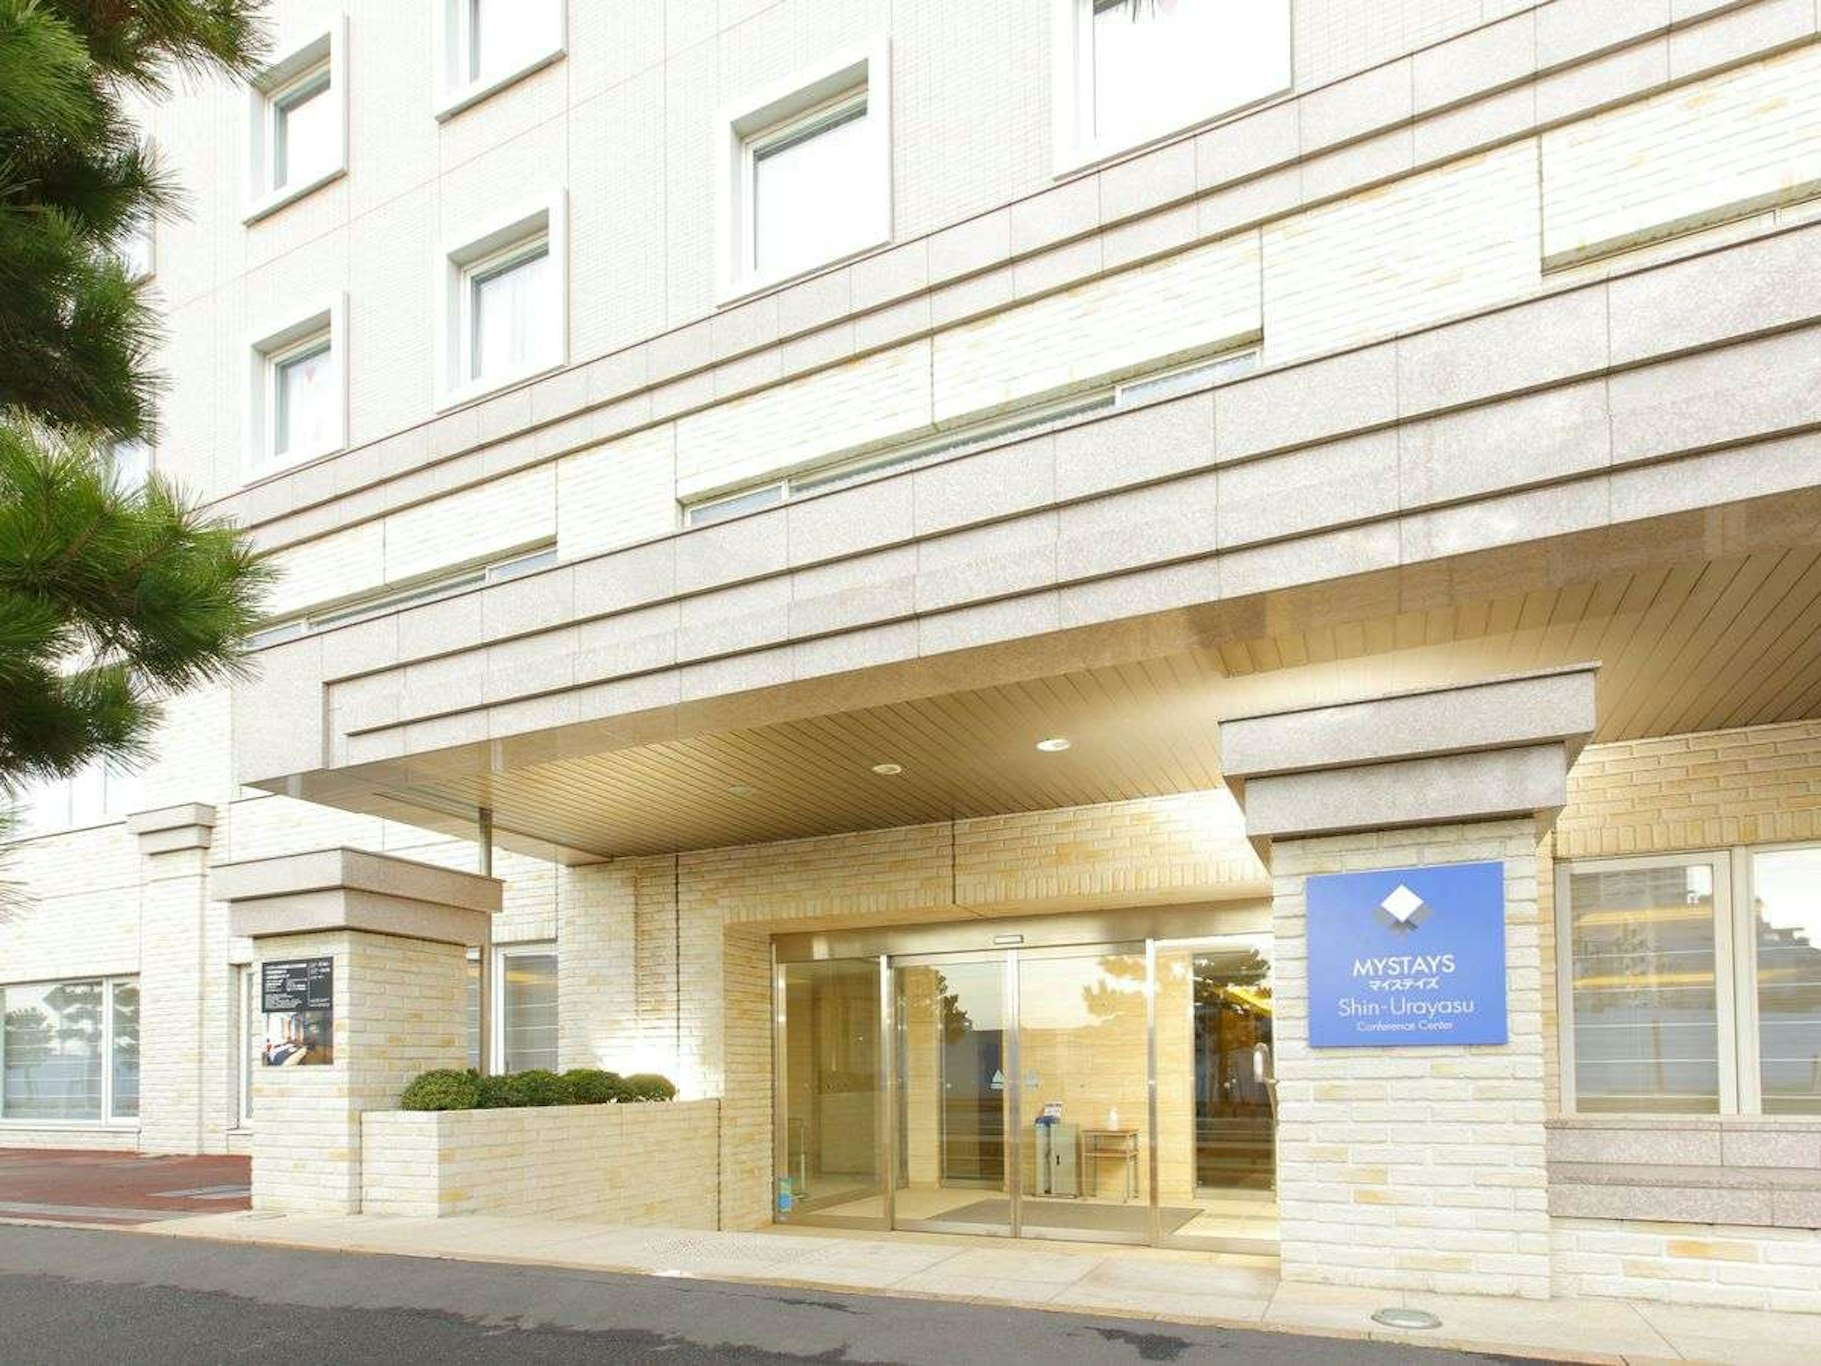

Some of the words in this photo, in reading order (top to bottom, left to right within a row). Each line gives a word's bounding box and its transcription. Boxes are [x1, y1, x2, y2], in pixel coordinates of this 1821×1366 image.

[1353, 955, 1455, 977] MYSTAYS
[1369, 977, 1439, 991] マイステイズ
[1358, 1022, 1415, 1032] Conference
[1420, 1020, 1453, 1031] Center
